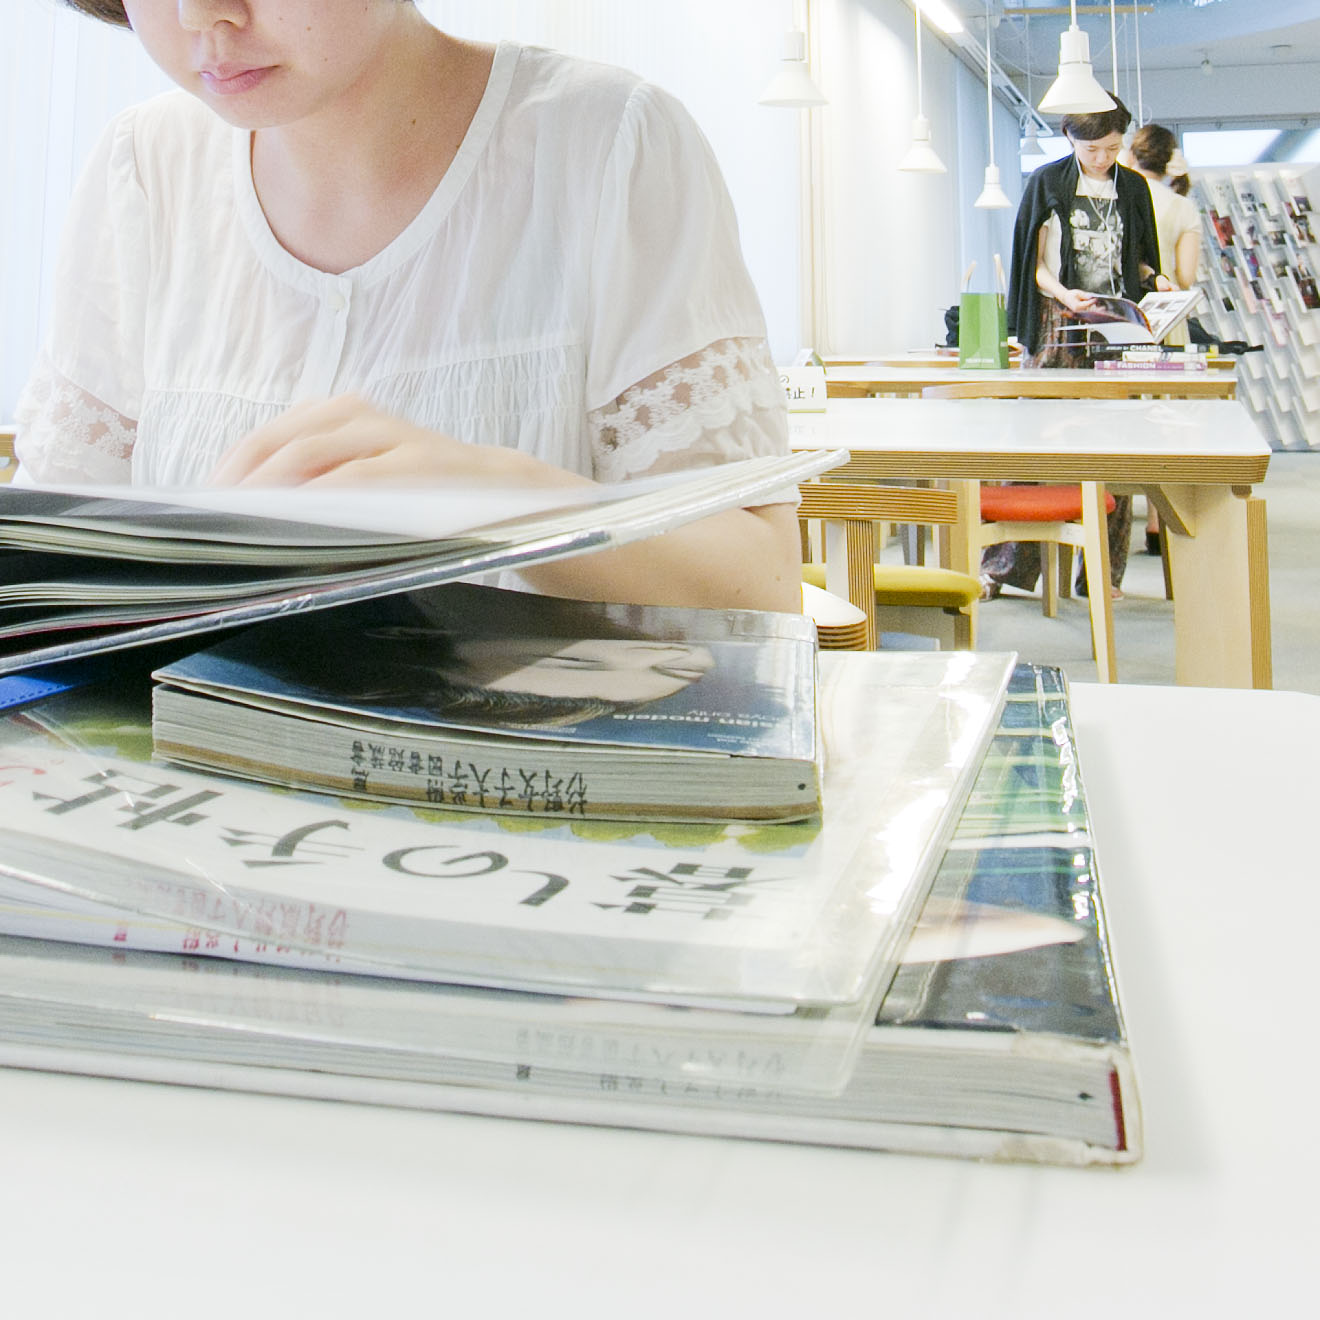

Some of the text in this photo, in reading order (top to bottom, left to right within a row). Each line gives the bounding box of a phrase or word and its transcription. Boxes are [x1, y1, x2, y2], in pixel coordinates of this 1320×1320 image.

[1116, 361, 1156, 369] FASHION
[613, 714, 710, 724] models
[32, 767, 792, 926] 暮しの手帖
